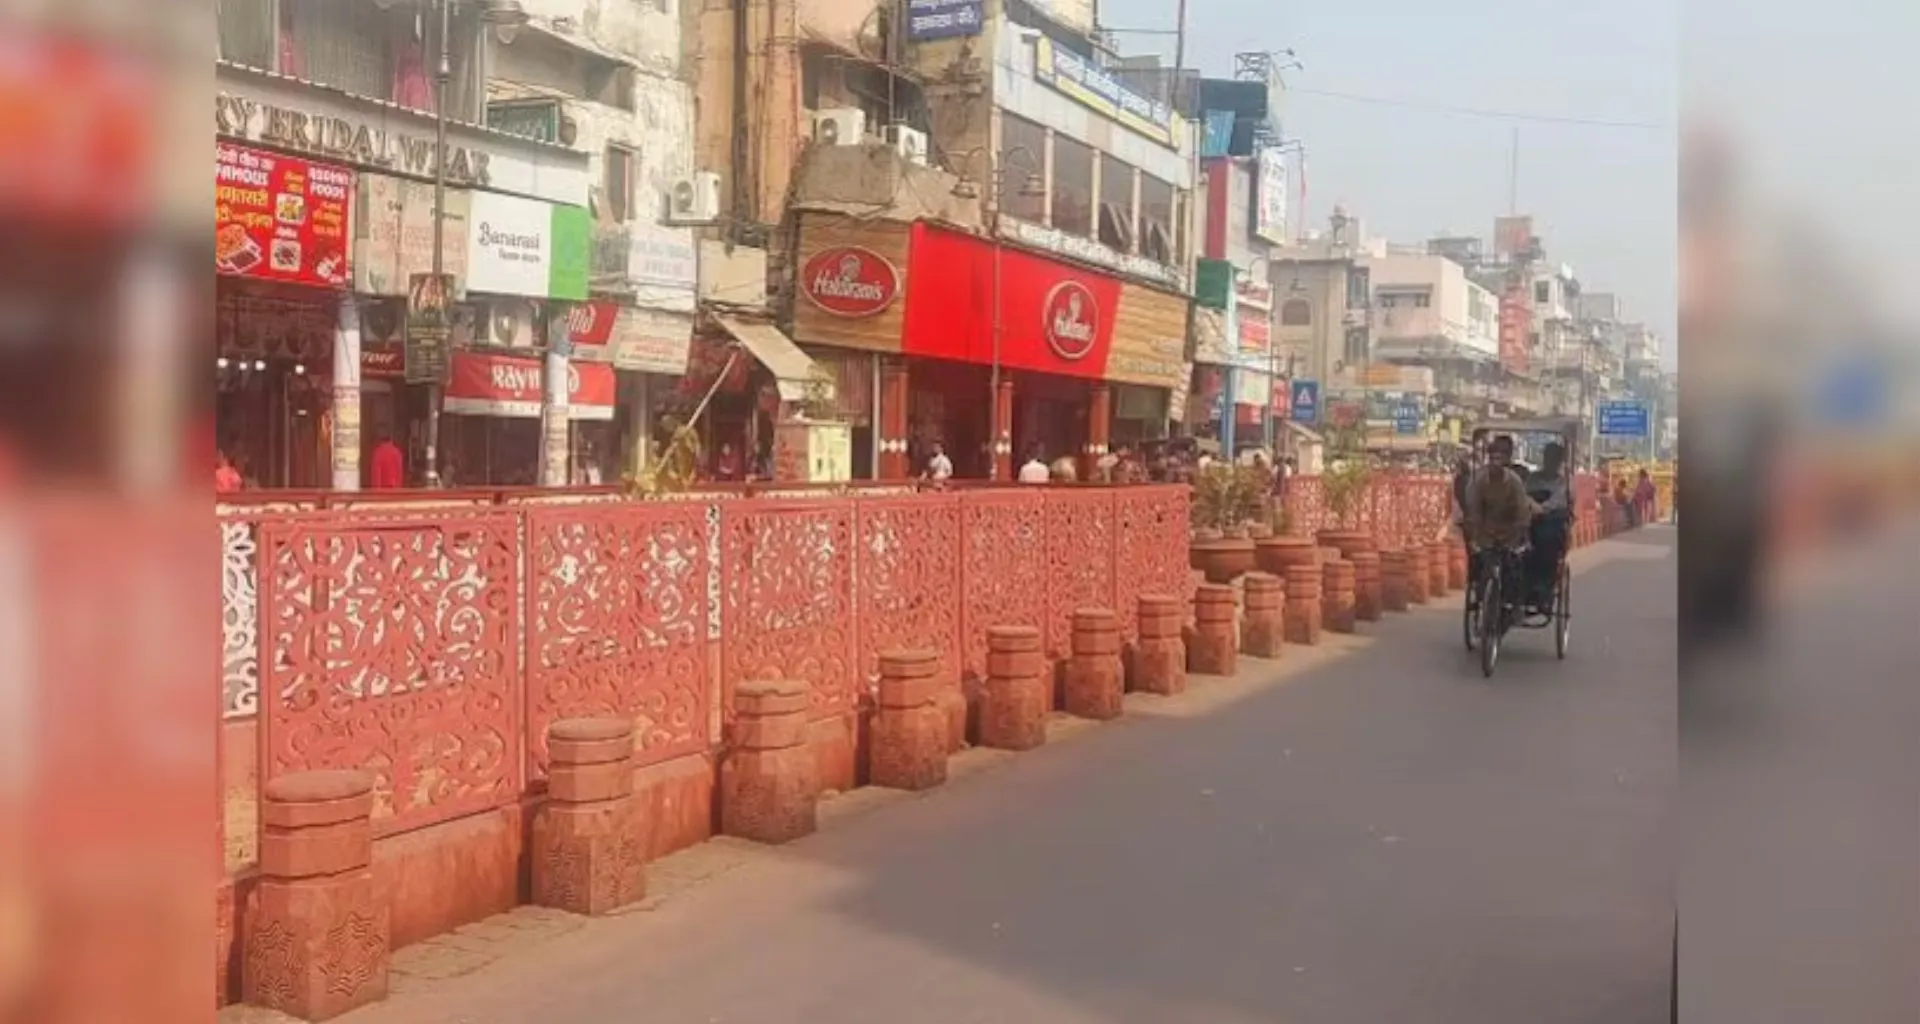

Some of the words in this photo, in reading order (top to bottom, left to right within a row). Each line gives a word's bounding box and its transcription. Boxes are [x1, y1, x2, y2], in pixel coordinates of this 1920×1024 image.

[268, 106, 396, 165] BRIDAL
[398, 133, 491, 185] WEAR
[478, 222, 540, 250] Banarasi
